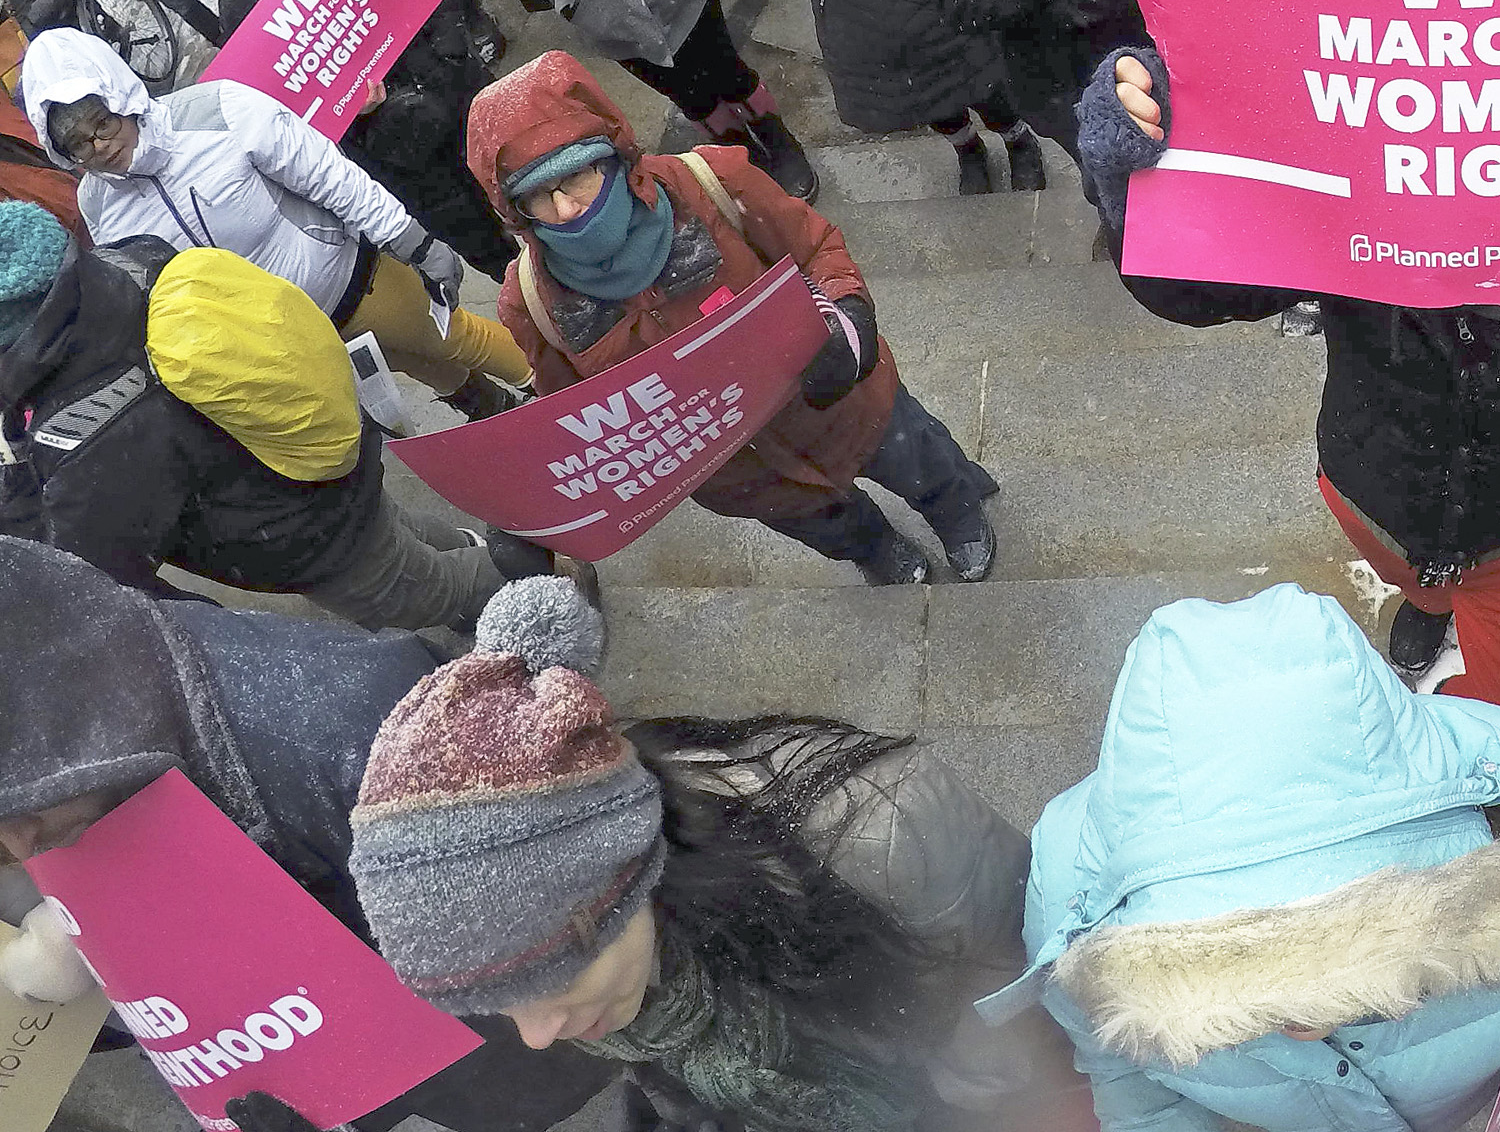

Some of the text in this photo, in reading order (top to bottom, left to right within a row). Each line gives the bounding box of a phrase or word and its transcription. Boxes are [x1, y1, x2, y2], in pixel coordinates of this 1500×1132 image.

[273, 4, 332, 77] MARCH
[316, 8, 379, 88] RIGHTS
[340, 76, 363, 108] Planned
[1375, 238, 1480, 268] Planned
[547, 388, 711, 479] MARCH FOR
[553, 382, 744, 500] WOMEN'S
[555, 372, 677, 443] WE
[613, 406, 744, 502] RIGHTS
[633, 487, 682, 524] Planned
